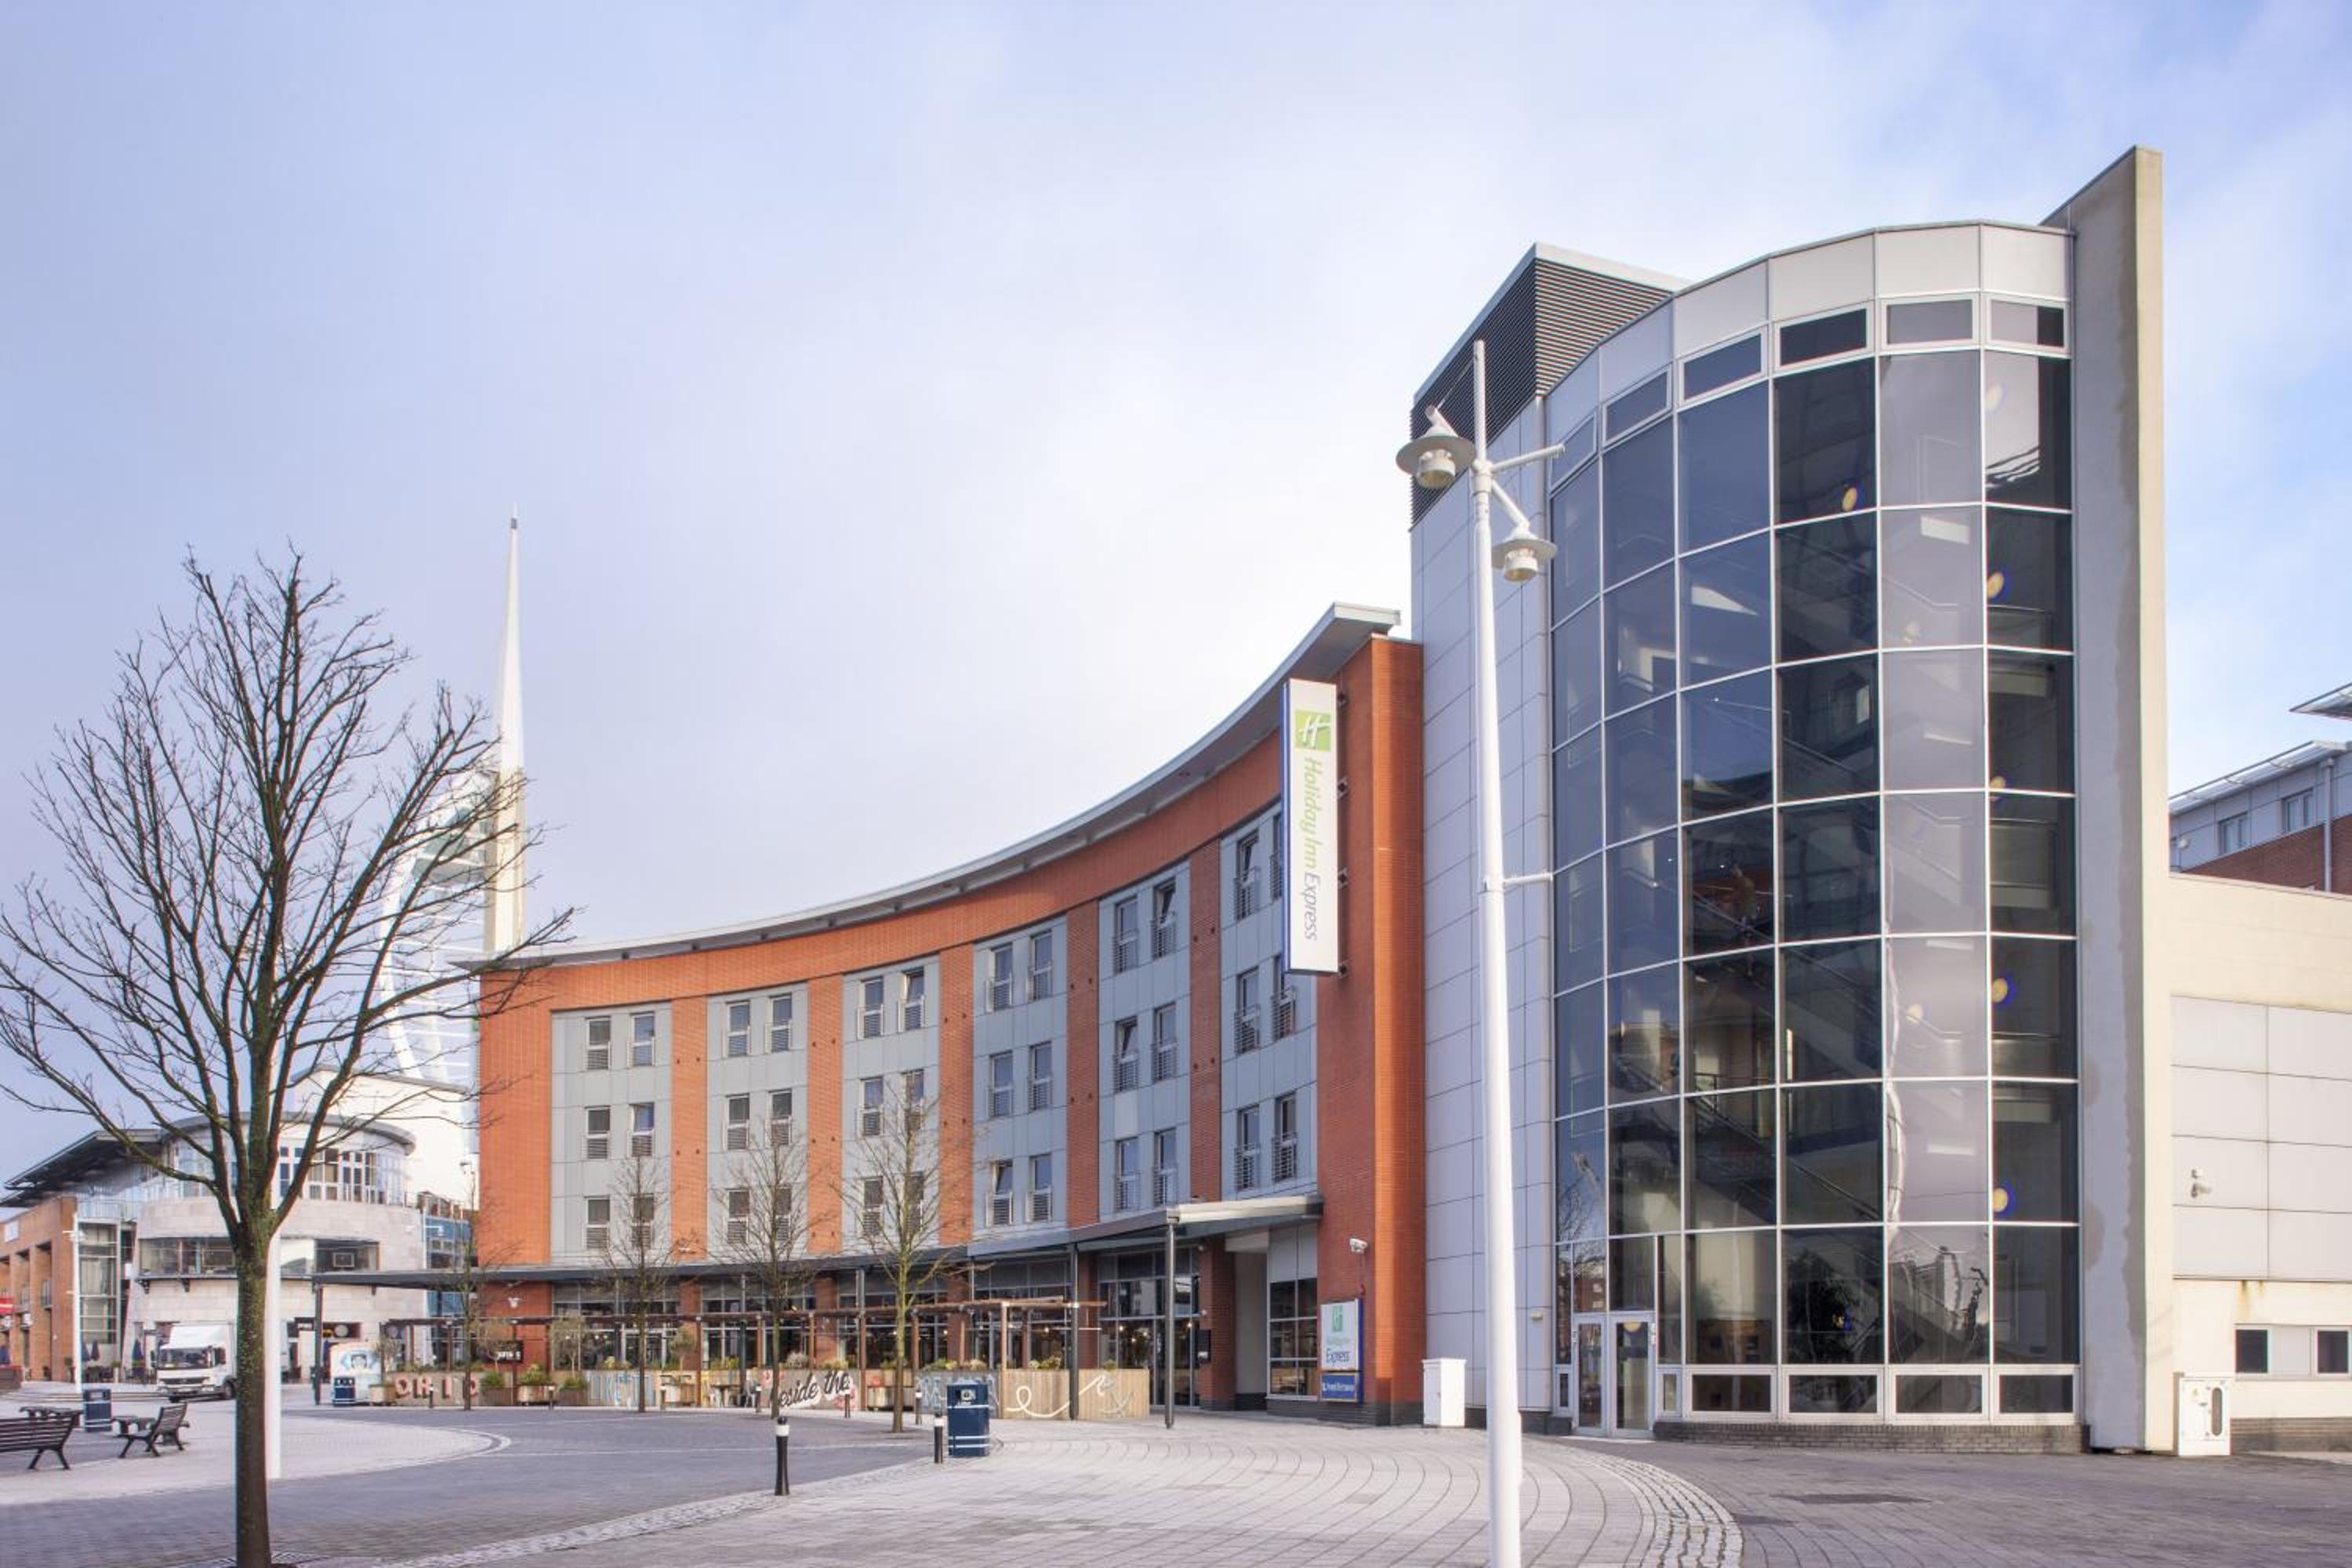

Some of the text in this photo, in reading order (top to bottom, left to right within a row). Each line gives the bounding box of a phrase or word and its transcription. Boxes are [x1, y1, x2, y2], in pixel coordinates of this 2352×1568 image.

[1299, 757, 1323, 942] Holiday Inn Express
